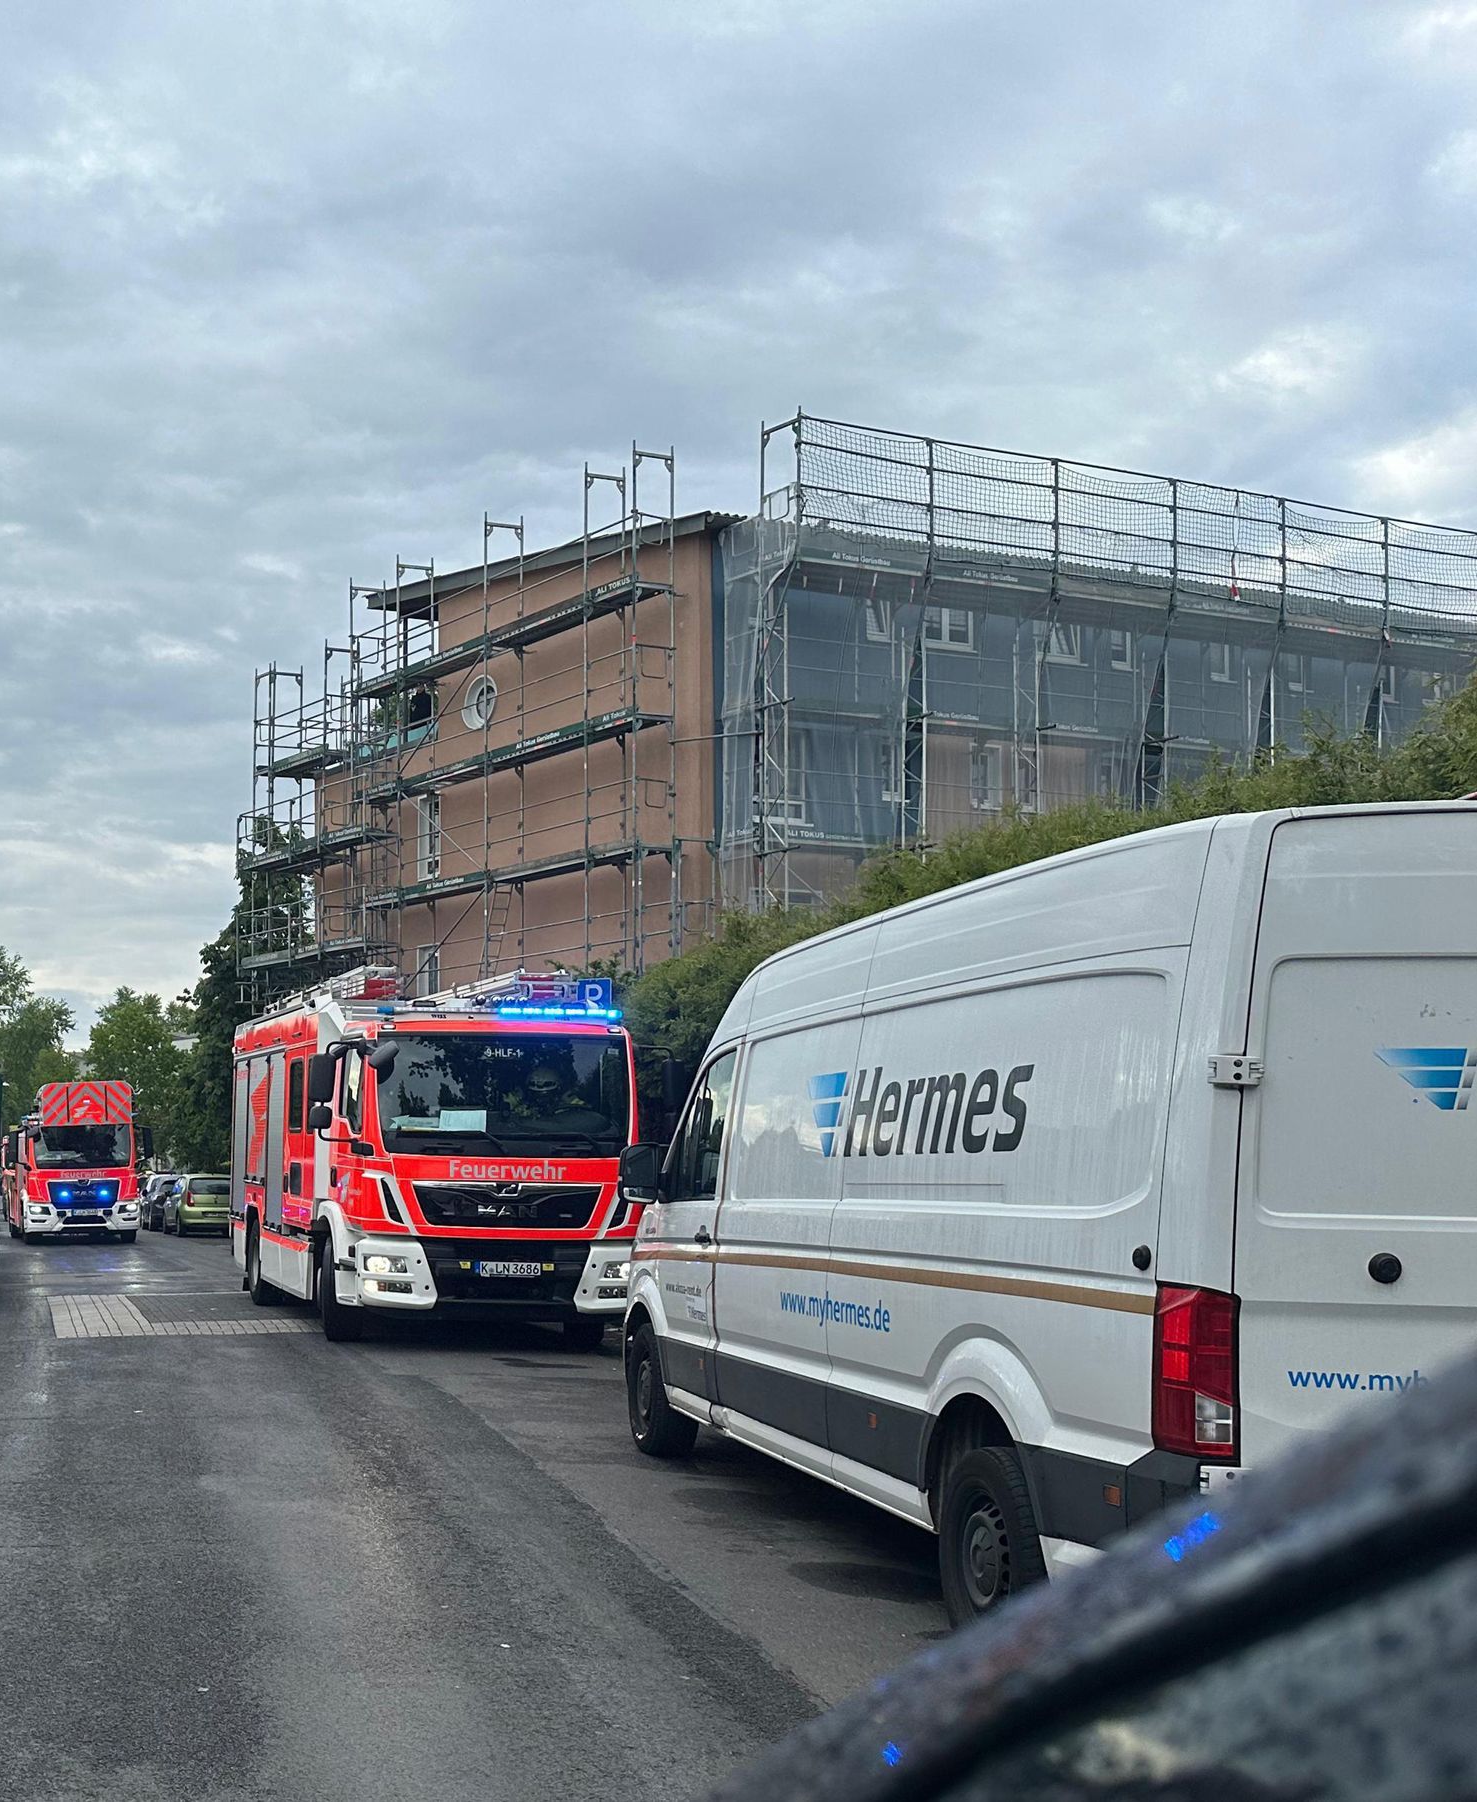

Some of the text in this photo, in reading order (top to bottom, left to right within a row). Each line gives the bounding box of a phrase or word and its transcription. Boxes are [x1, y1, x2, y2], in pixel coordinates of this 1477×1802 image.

[832, 551, 841, 560] Ali
[841, 553, 860, 562] Tokus
[595, 576, 631, 597] ALI TOKUS
[800, 831, 825, 839] TOKUS
[844, 1064, 1035, 1157] Hermes
[449, 1159, 567, 1180] Feuerwehr
[481, 1263, 488, 1274] K
[512, 1264, 540, 1275] 3686
[780, 1290, 890, 1332] www.myhermes.de
[1287, 1370, 1429, 1393] www.myh
